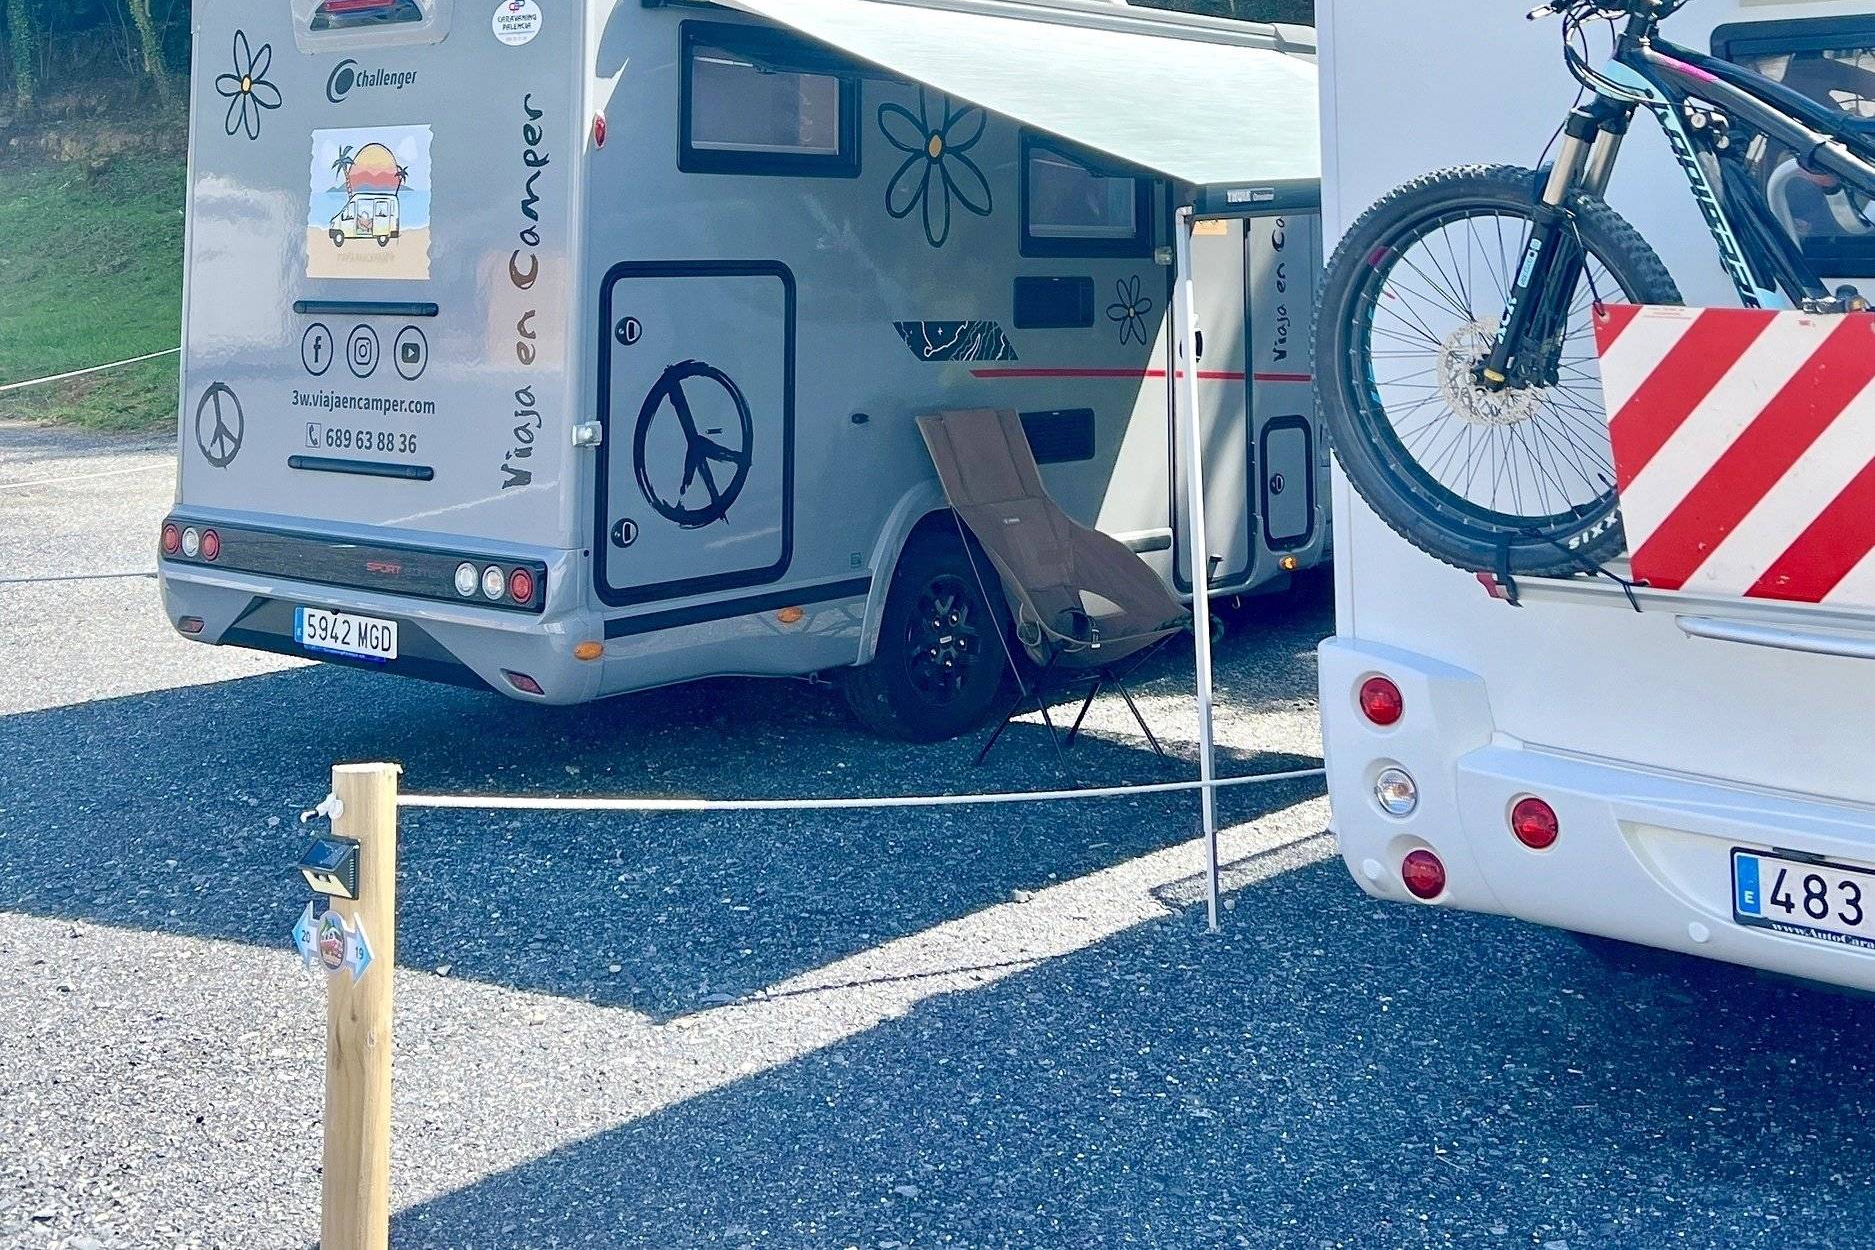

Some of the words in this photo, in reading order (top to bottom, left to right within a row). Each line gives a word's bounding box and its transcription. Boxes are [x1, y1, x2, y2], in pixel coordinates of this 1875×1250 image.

[356, 68, 418, 90] Challenger
[508, 92, 550, 291] Camper
[1275, 261, 1287, 294] en
[515, 308, 537, 367] en
[1272, 302, 1291, 363] Viaja
[291, 389, 436, 416] 3w.viajaencamper.com
[326, 427, 352, 449] 689
[355, 429, 374, 451] 63
[376, 431, 396, 453] 88
[398, 433, 418, 455] 36
[500, 383, 543, 490] Viaja
[307, 613, 352, 646] 5942
[358, 621, 392, 653] MGD
[1744, 890, 1755, 905] E
[1770, 868, 1864, 927] 483
[301, 929, 311, 944] 20
